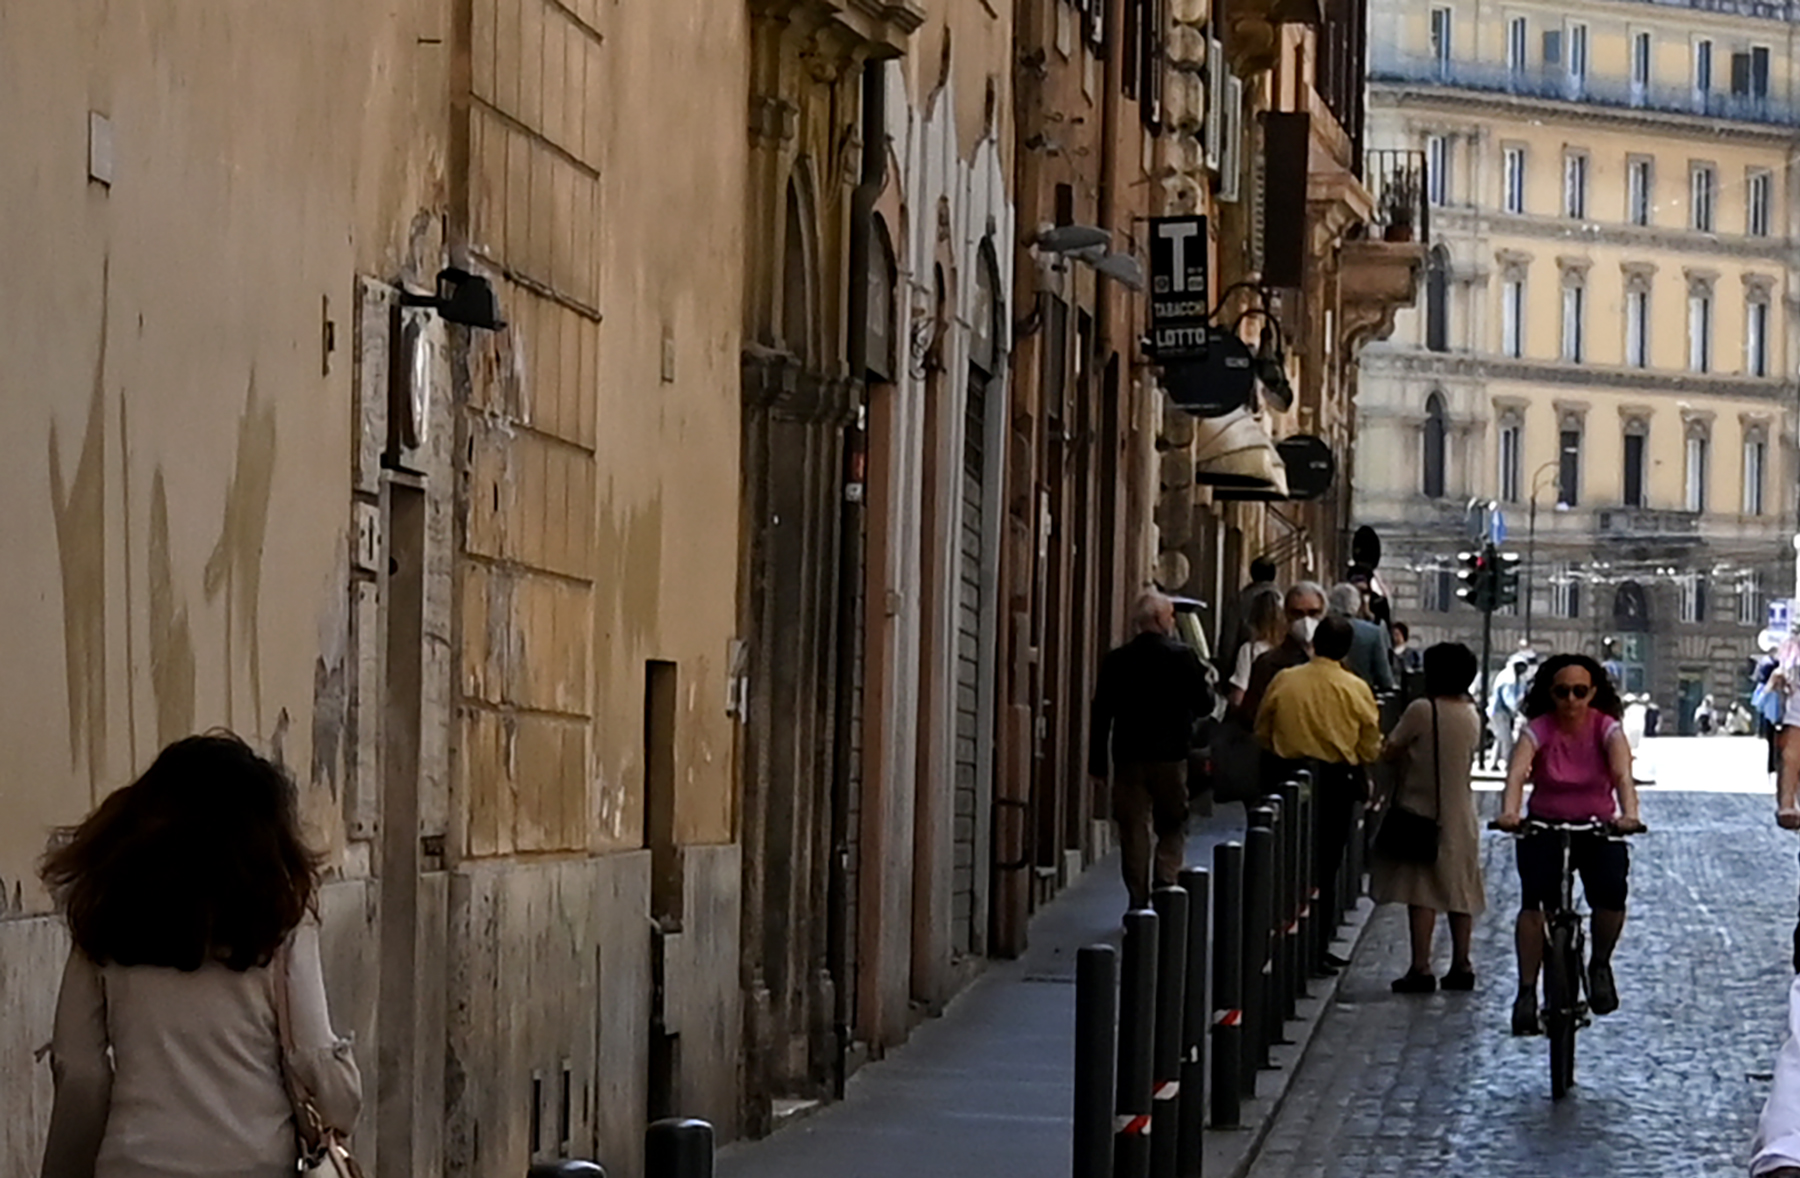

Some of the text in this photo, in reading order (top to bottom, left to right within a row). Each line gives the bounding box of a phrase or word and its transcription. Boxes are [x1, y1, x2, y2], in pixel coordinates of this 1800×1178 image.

[1158, 222, 1198, 291] T
[1154, 301, 1205, 317] TABACCHI
[1156, 328, 1205, 347] LOTTO
